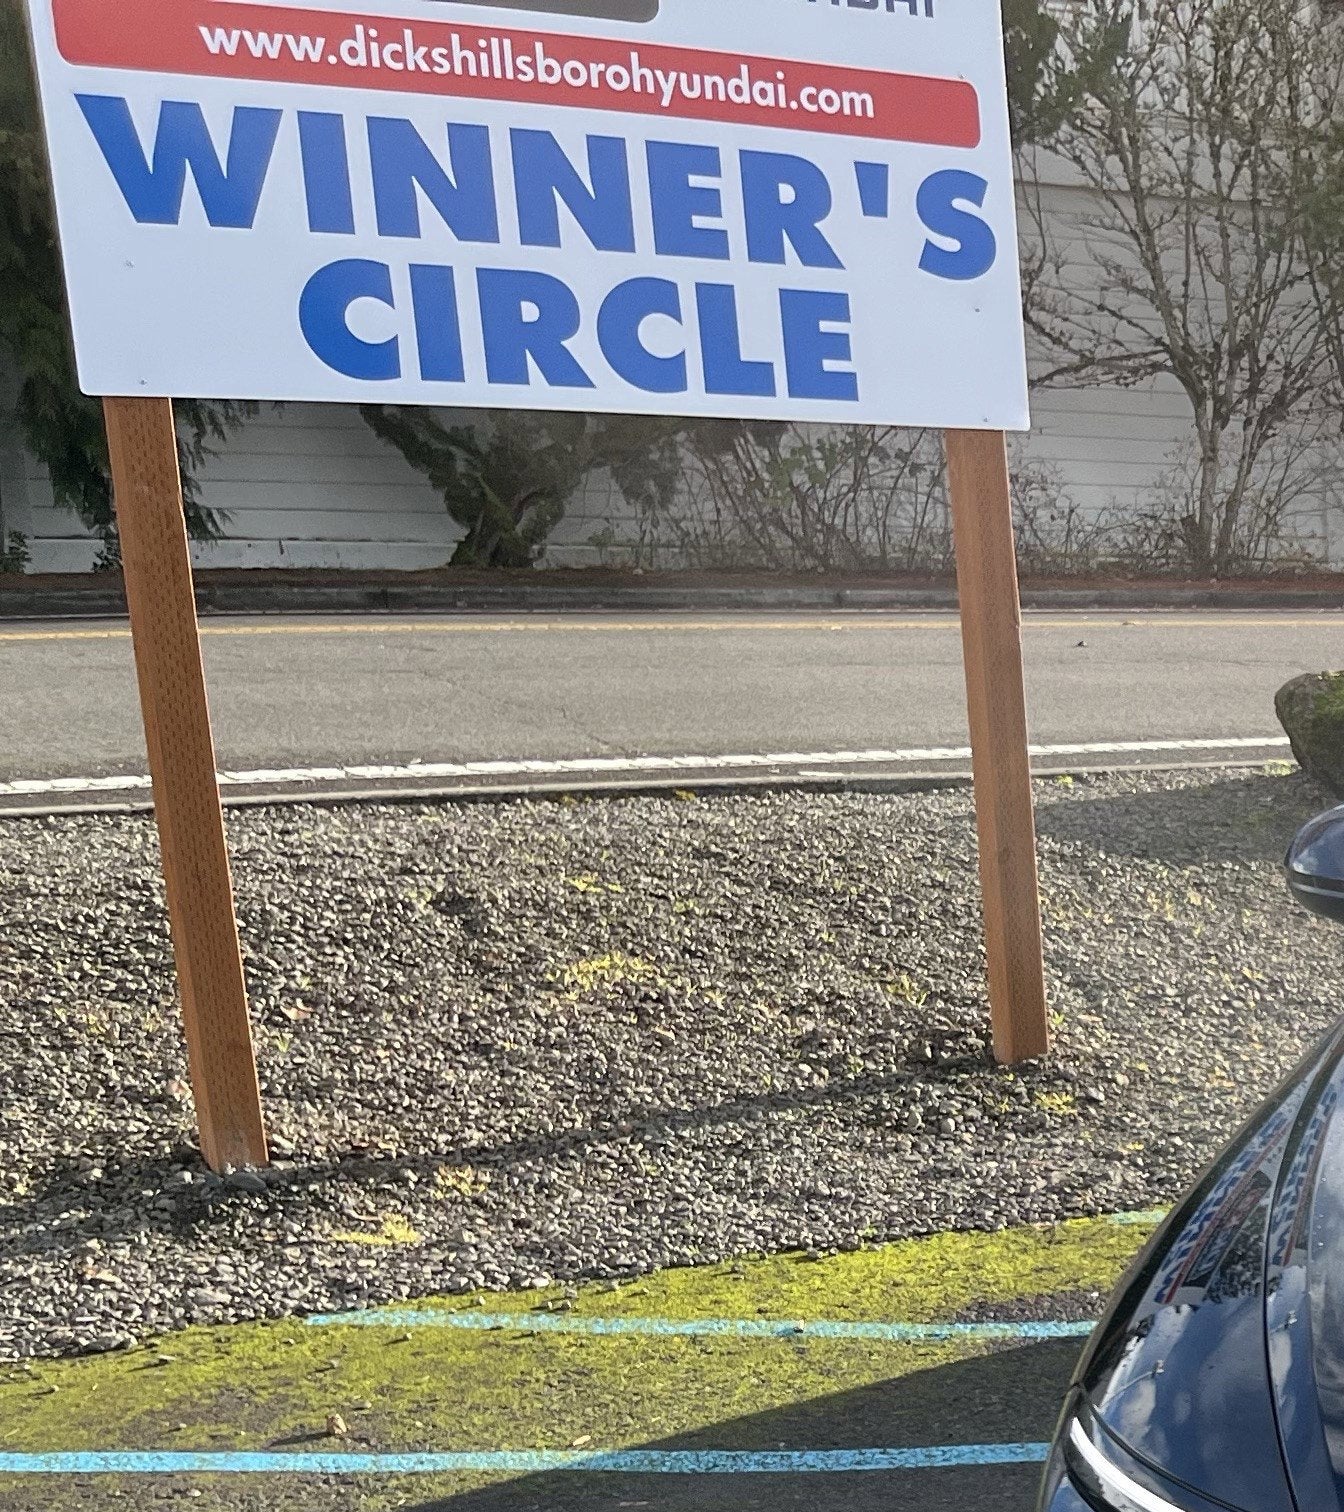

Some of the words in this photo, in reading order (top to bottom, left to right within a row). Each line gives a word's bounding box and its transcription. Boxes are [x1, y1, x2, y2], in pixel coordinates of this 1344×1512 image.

[198, 25, 875, 120] www.dickshillsborohyundai.com
[73, 92, 998, 282] WINNER'S
[298, 258, 859, 402] CIRCLE
